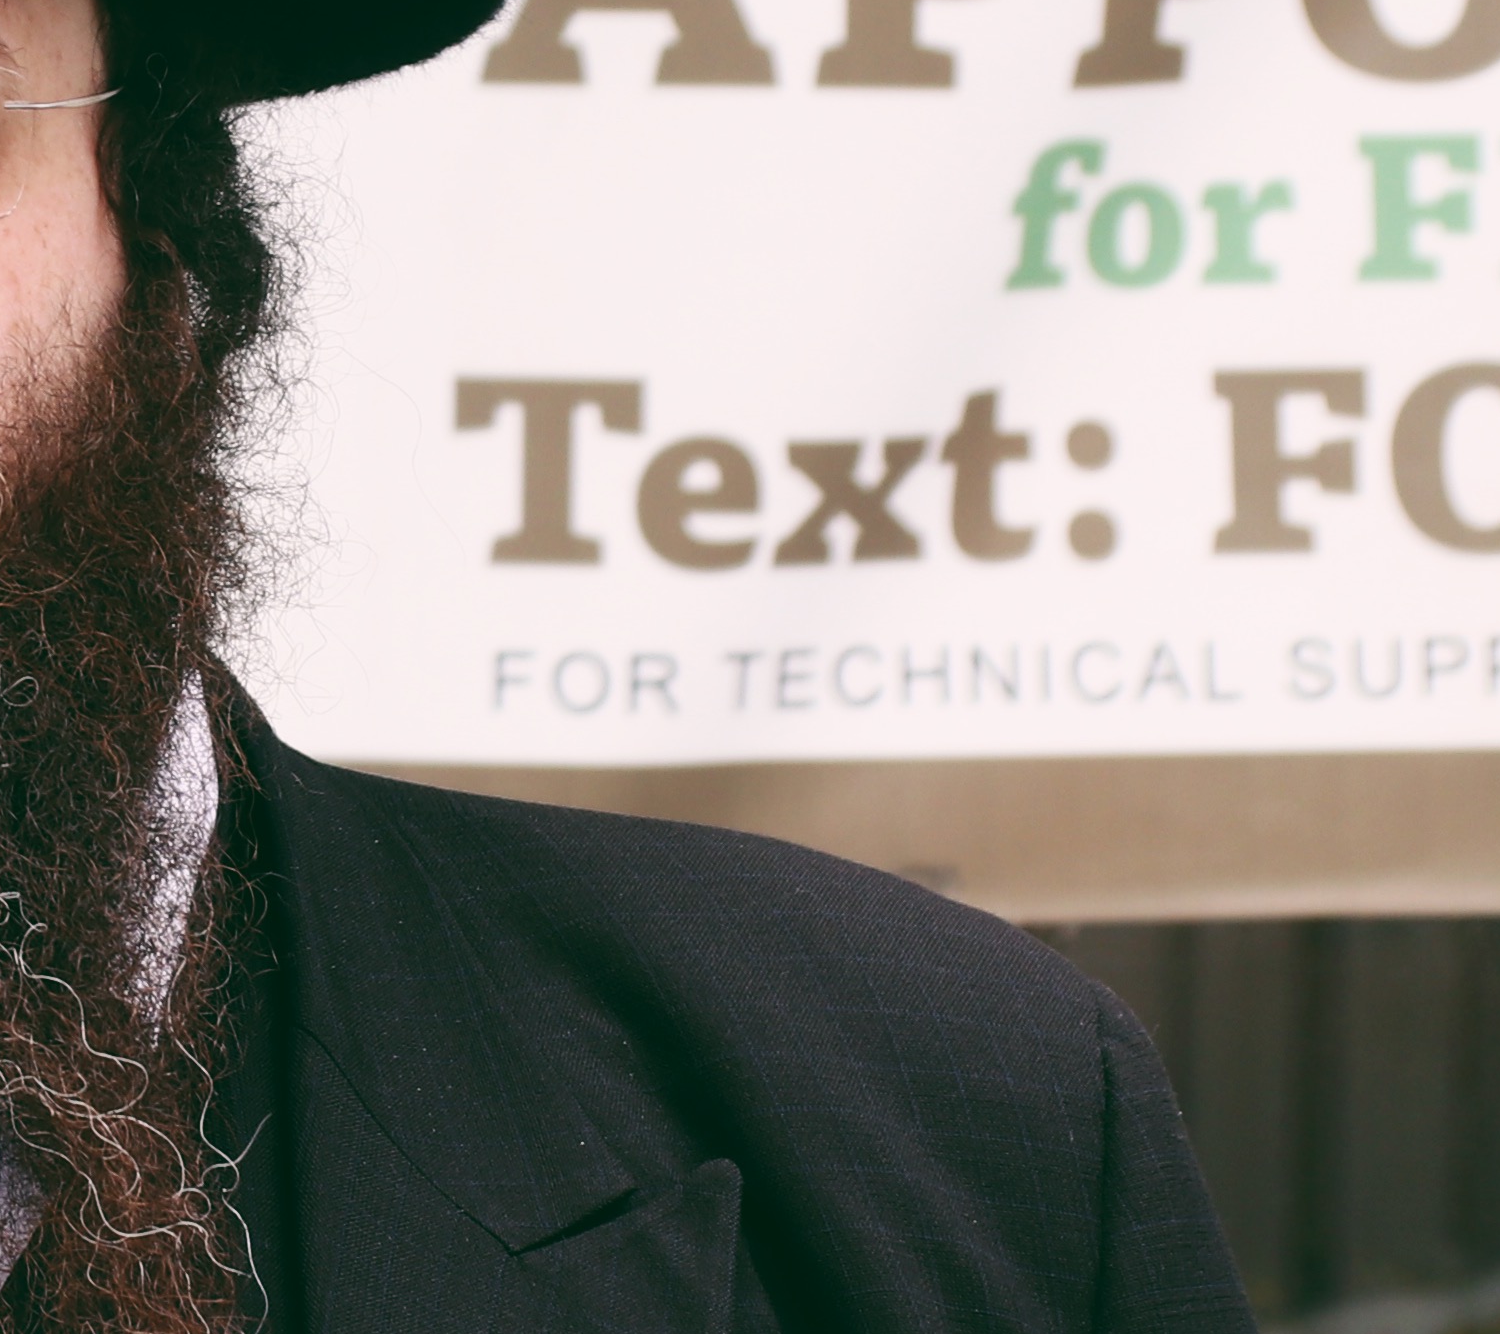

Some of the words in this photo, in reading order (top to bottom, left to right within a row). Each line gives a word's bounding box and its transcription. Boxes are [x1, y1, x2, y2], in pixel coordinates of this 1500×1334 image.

[1000, 135, 1294, 295] for
[452, 375, 1118, 574] Text:
[491, 648, 680, 716] FOR
[722, 637, 1240, 713] TECHNICAL
